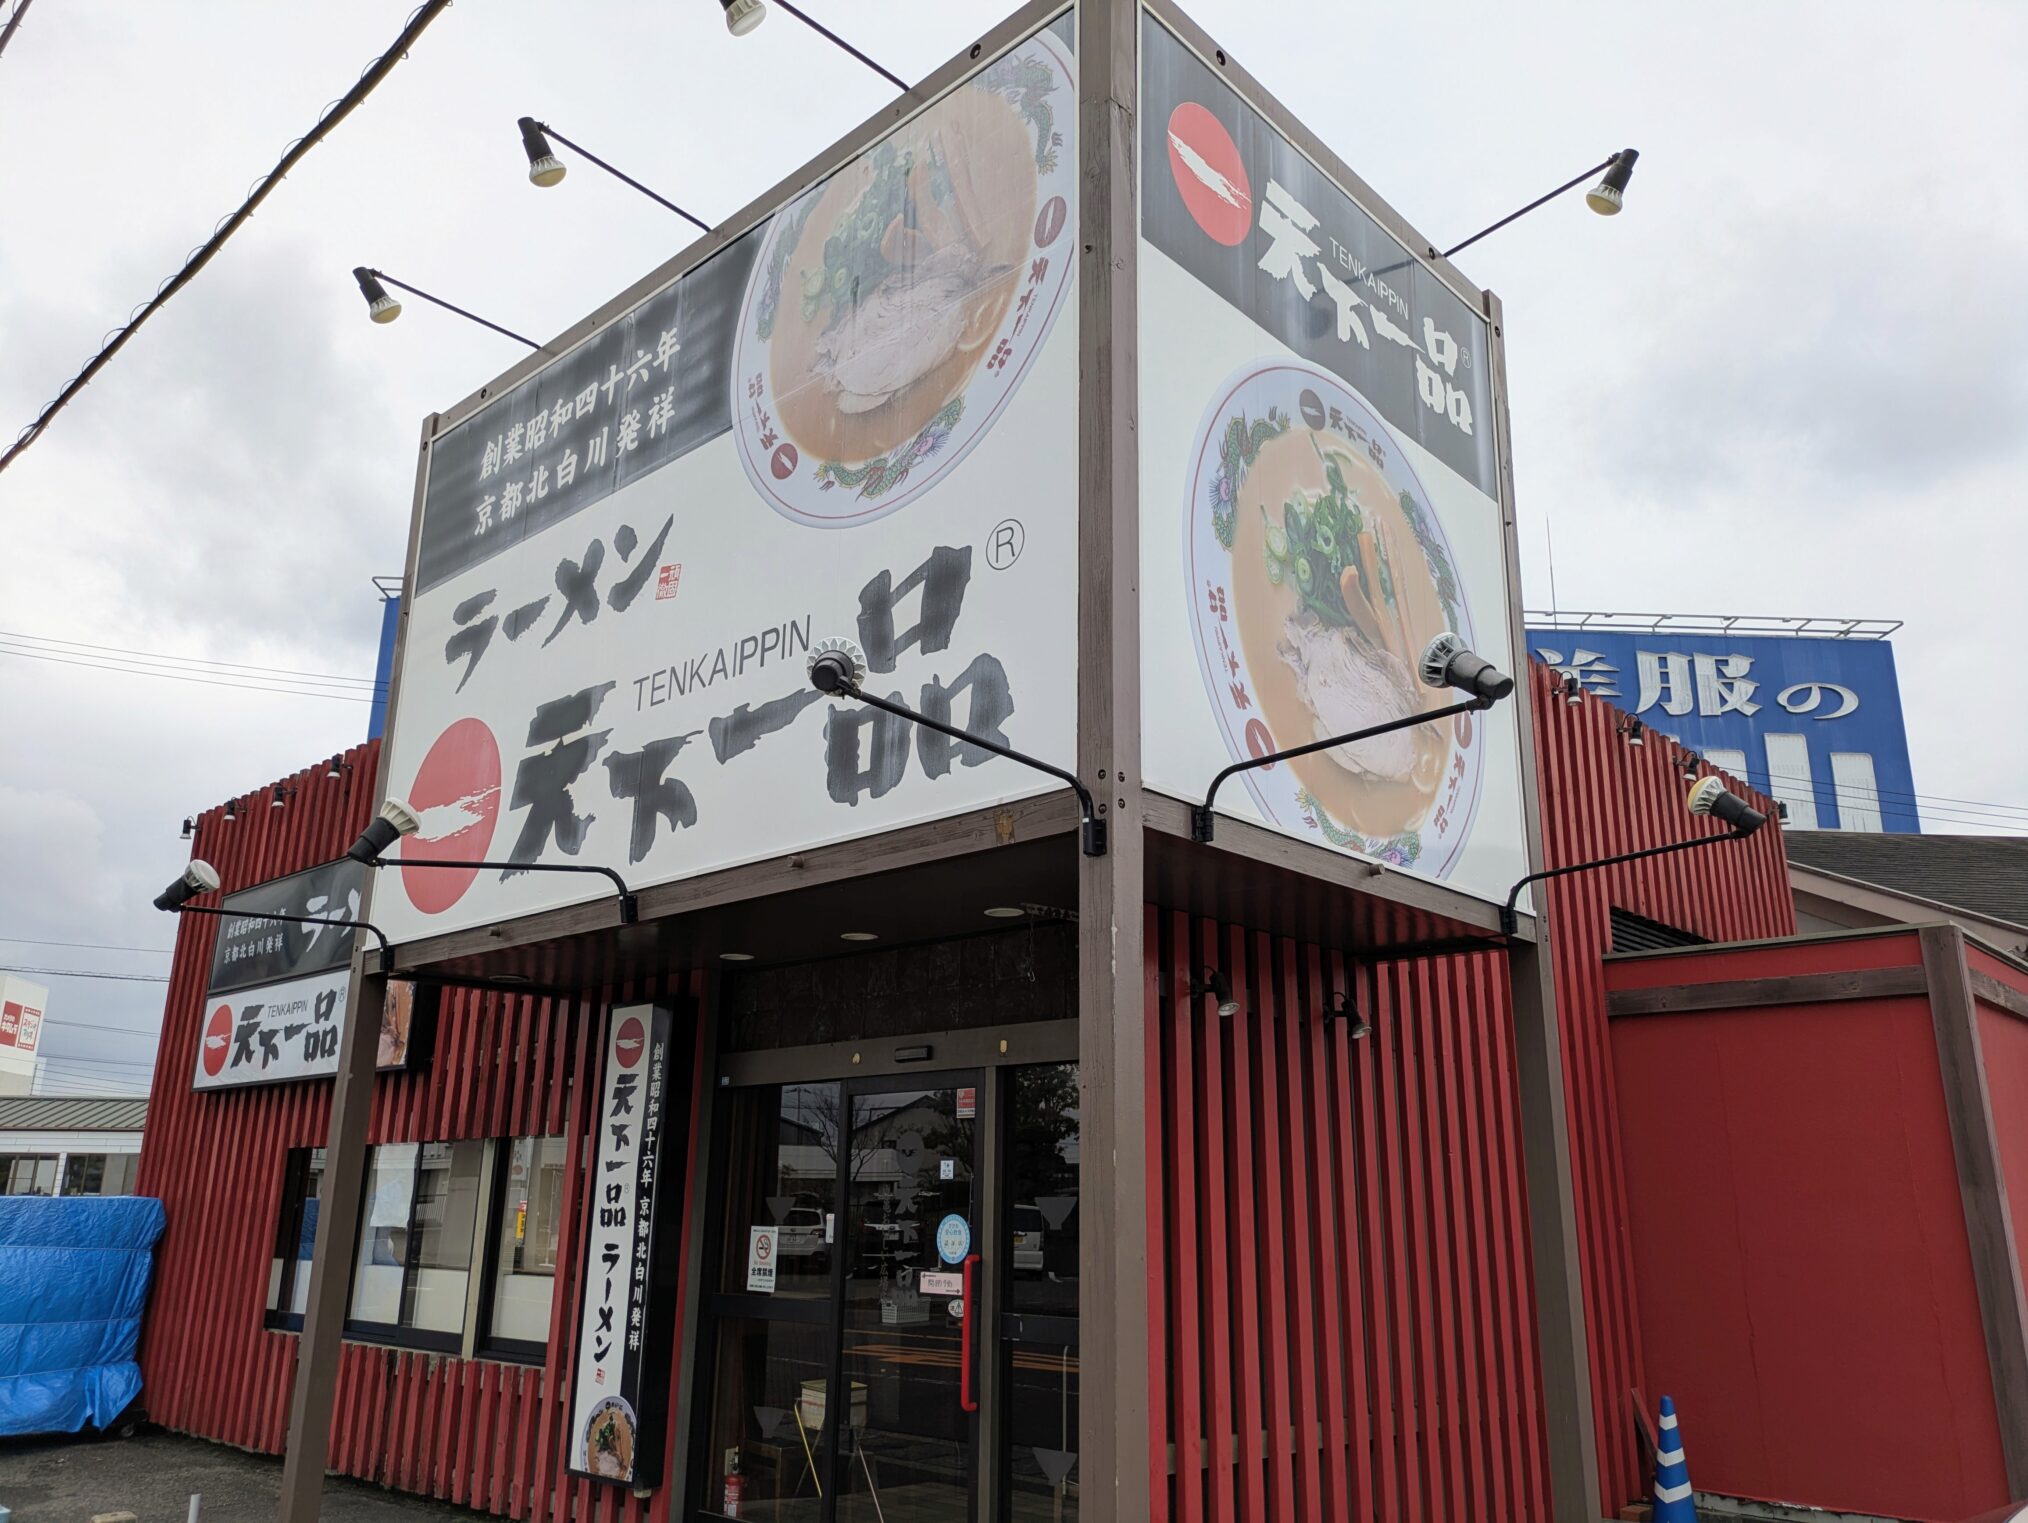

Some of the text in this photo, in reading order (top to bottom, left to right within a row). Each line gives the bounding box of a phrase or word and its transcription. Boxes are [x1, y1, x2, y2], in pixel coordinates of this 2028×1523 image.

[1257, 178, 1473, 436] 天下一品
[1329, 236, 1409, 321] TENKAIPPIN
[473, 385, 676, 537] 京都北白川発祥
[479, 326, 682, 482] 創業昭和四十六年
[444, 513, 674, 694] ラーメン
[633, 614, 813, 713] TENKAIPPIN
[498, 545, 1015, 885] 天下一品
[223, 932, 284, 965] 京都北白川発祥
[267, 999, 309, 1019] TENKAIPPIN
[230, 988, 339, 1070] 天下一品
[599, 1073, 640, 1228] 天下一品
[640, 1042, 665, 1189] 創業昭和四十六年
[593, 1243, 620, 1363] ラーメン
[628, 1197, 651, 1352] 京都北白川発祥
